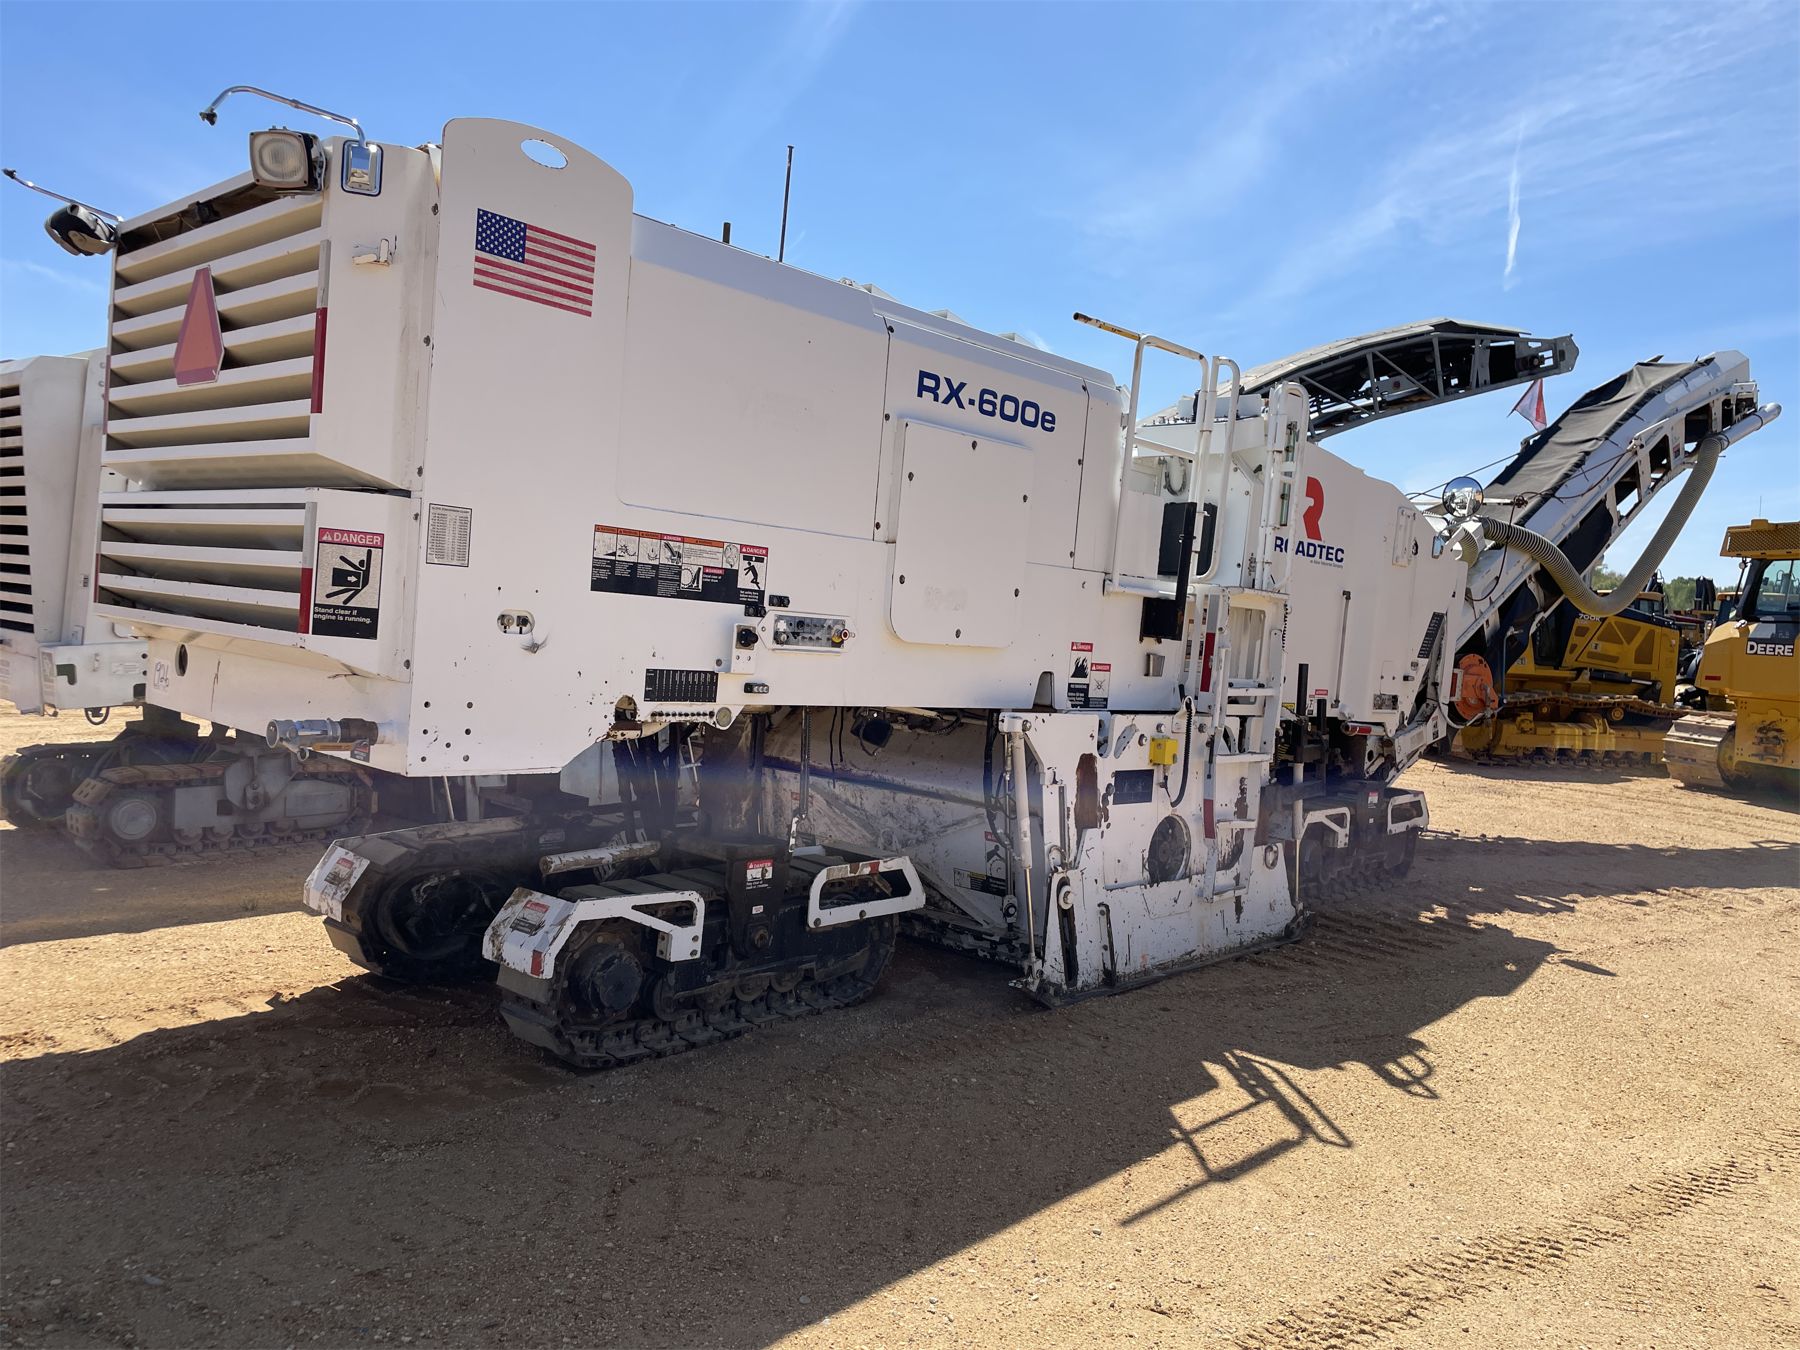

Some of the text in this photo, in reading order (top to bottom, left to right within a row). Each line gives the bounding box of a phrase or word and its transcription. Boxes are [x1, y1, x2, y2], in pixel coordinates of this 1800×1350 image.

[917, 369, 1056, 433] RX-600e
[333, 532, 381, 545] DANGER
[746, 547, 767, 555] DANGER
[313, 613, 336, 621] engine
[344, 616, 373, 624] running.
[1746, 641, 1794, 656] DEERE
